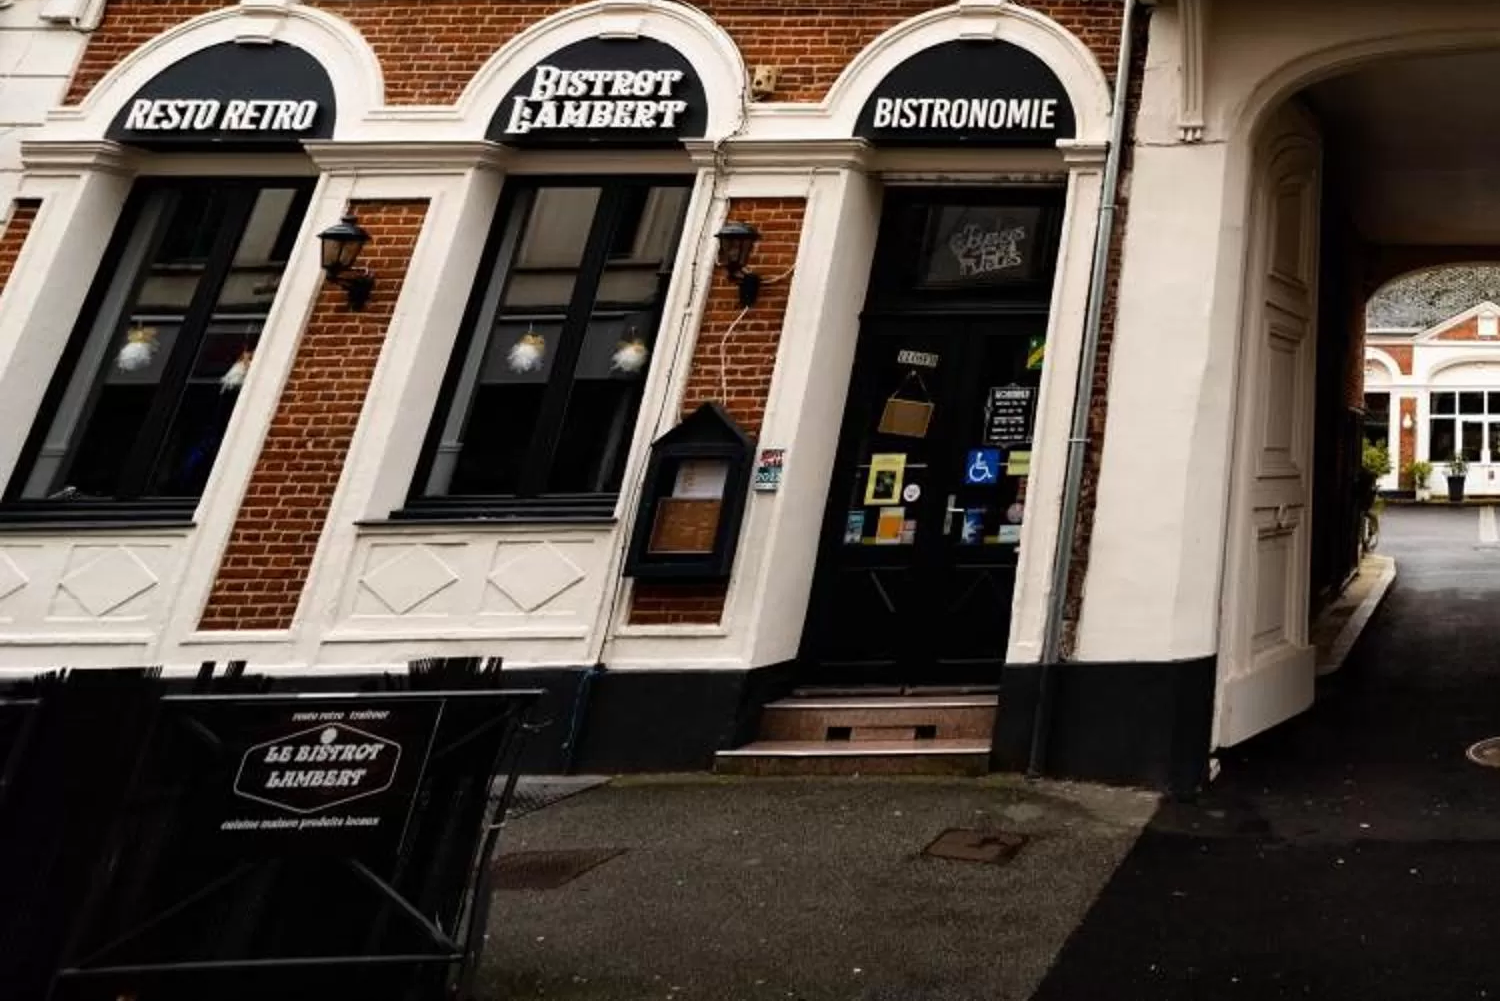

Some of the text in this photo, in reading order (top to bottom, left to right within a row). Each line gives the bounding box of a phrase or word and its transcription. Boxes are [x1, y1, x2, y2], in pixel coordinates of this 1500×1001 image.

[528, 65, 684, 102] BISTROT
[124, 98, 321, 130] RESTO RETRO
[504, 96, 688, 134] LAMBERT
[873, 97, 1059, 129] BISTRONOMIE
[264, 743, 385, 763] LE BISTROT
[265, 768, 367, 789] LAMBERT
